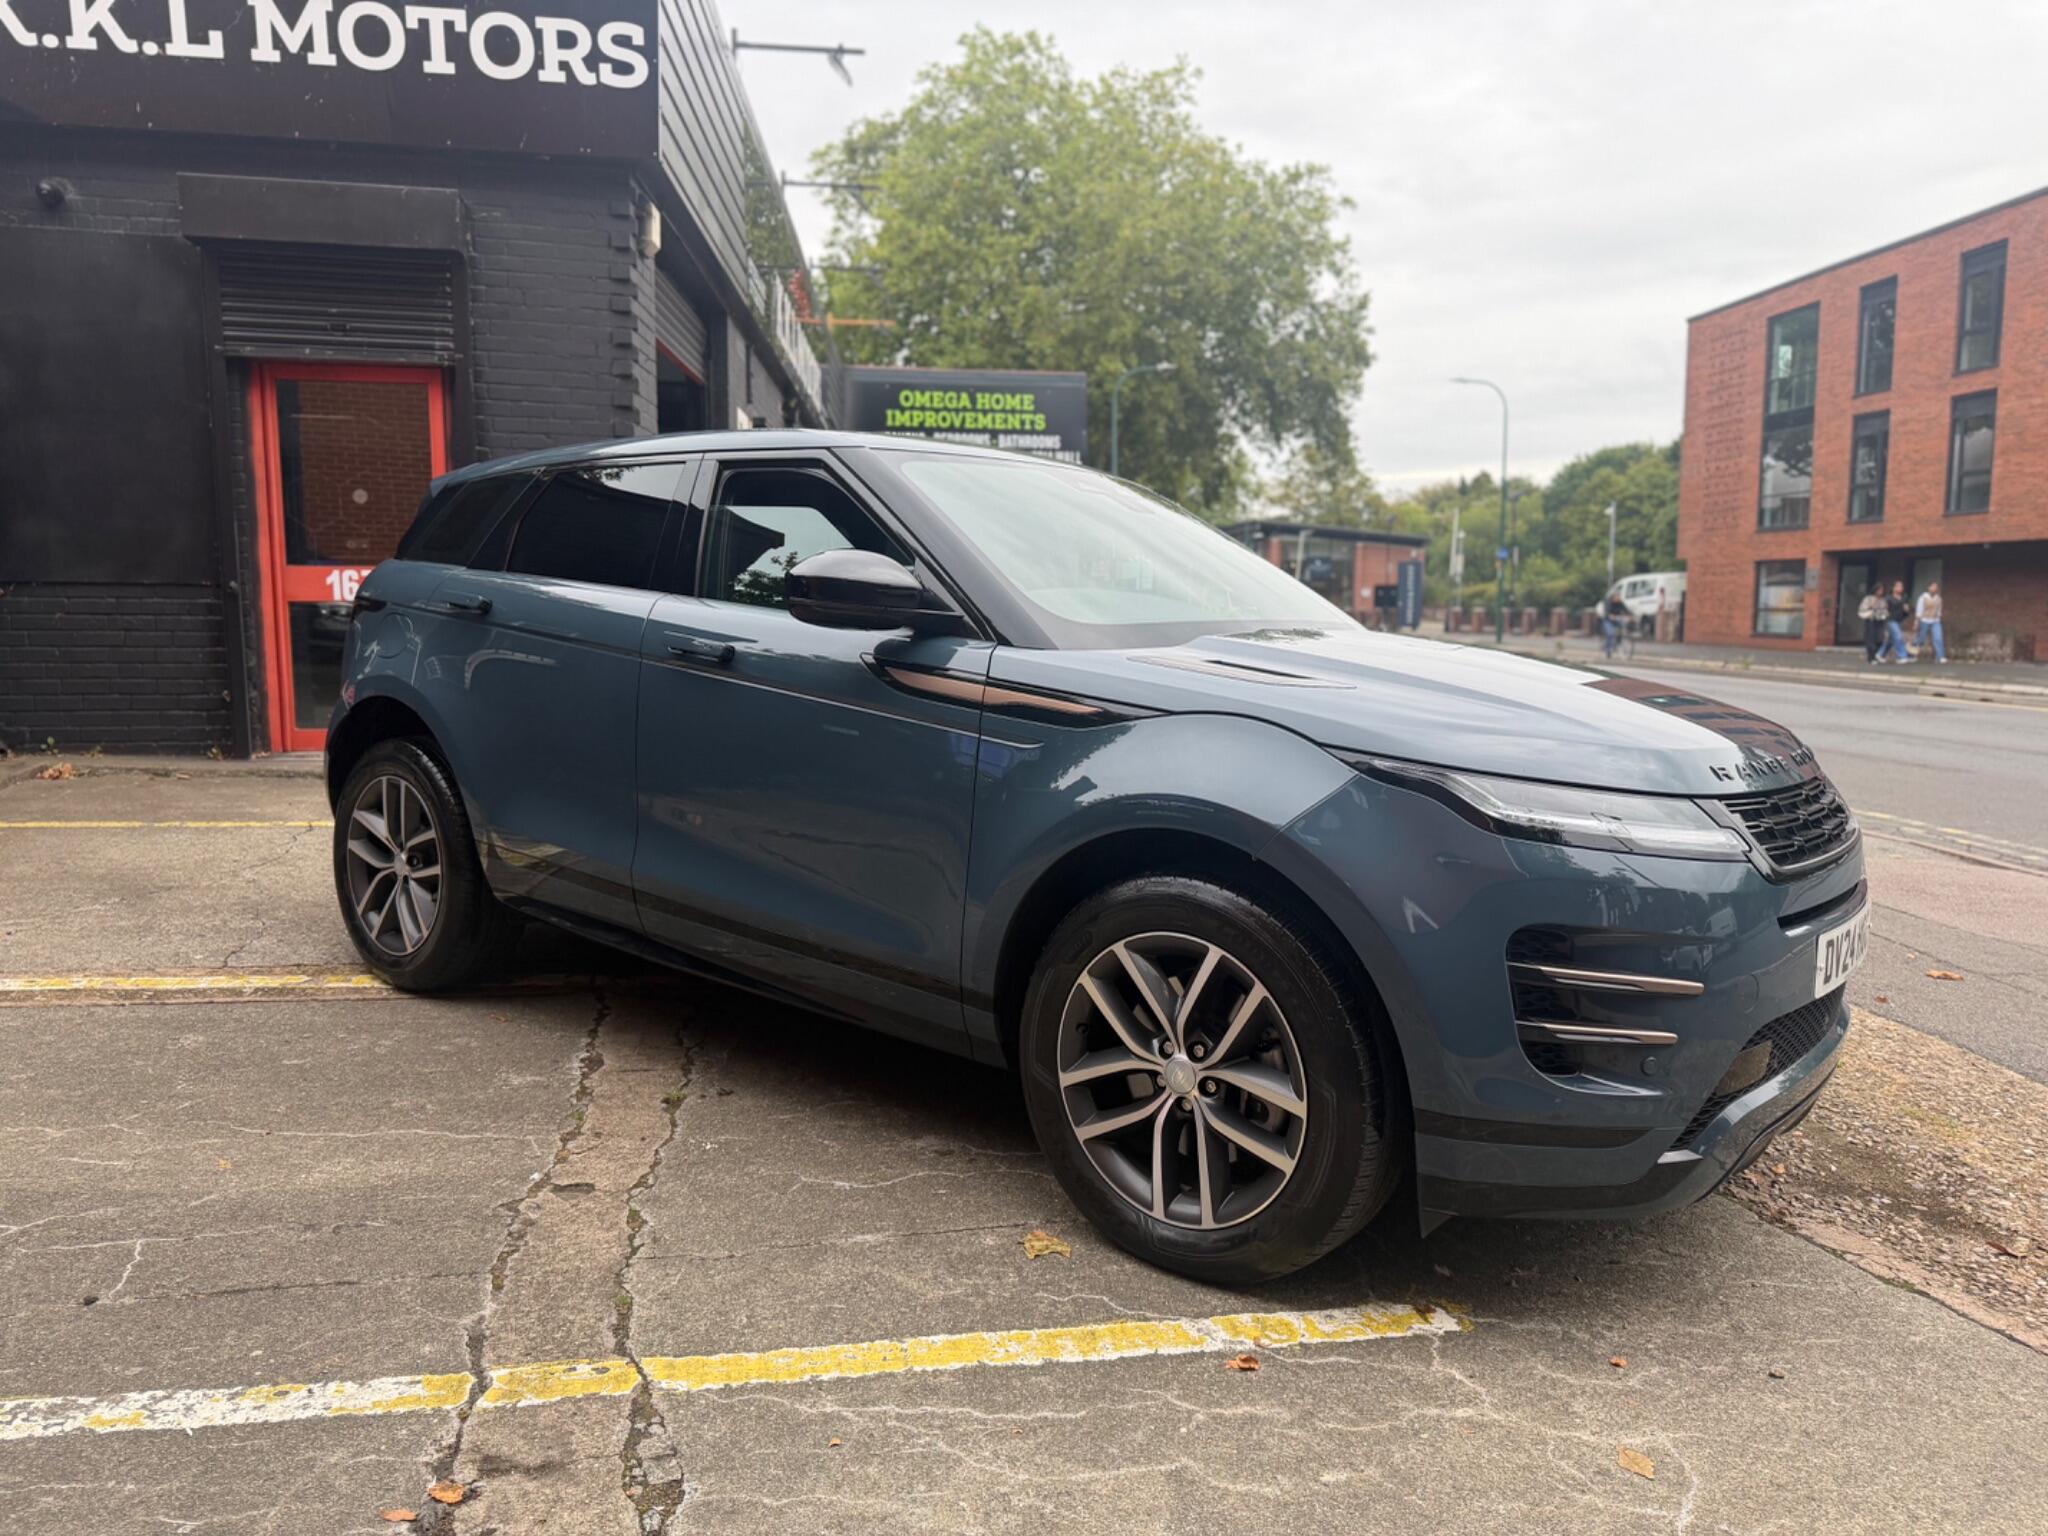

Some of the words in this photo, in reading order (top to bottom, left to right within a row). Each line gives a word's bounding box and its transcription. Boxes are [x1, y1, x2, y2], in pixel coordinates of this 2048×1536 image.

[247, 0, 650, 89] MOTORS
[899, 389, 972, 410] OMEGA
[976, 392, 1036, 411] HOME
[885, 409, 1047, 431] IMPROVEMENTS
[325, 569, 373, 601] 16
[1709, 756, 1788, 781] RANGE
